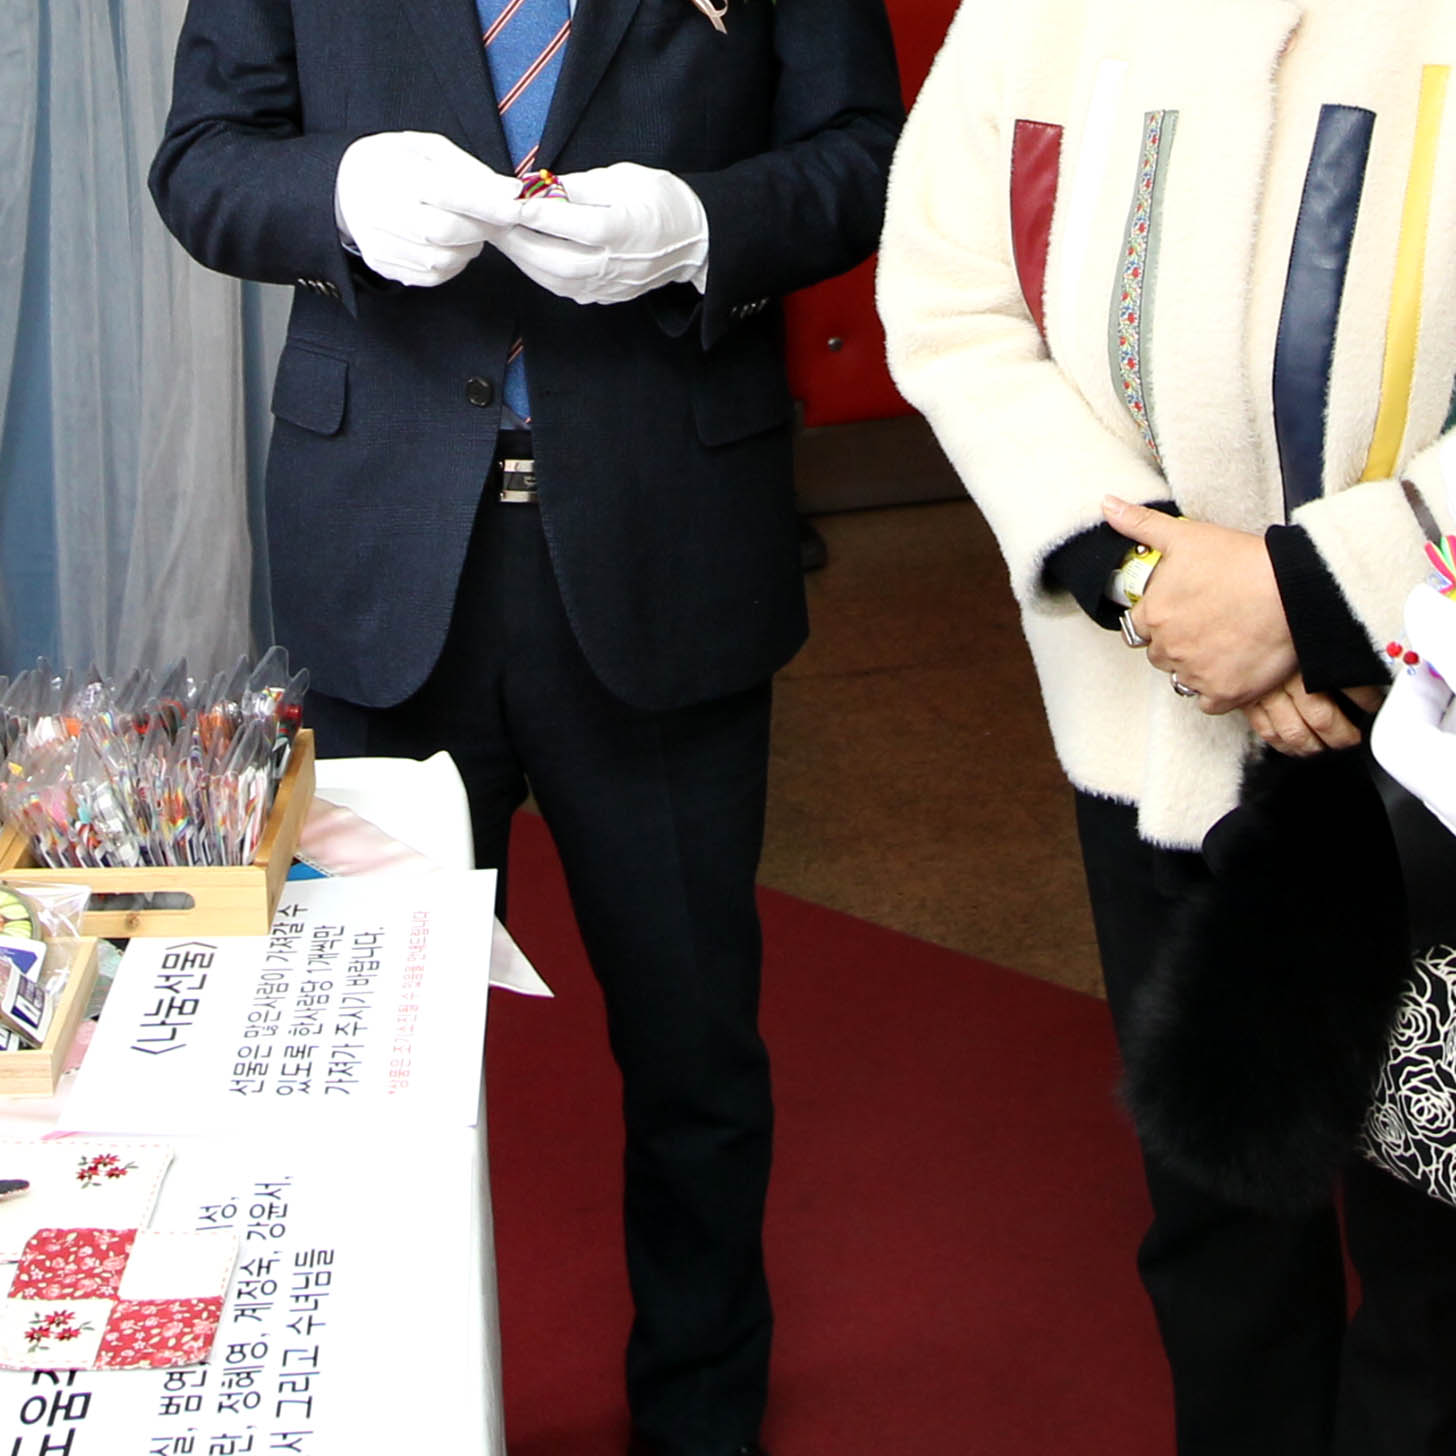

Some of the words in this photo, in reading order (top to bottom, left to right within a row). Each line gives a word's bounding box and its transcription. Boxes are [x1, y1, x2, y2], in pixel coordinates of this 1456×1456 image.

[277, 904, 308, 917] 수
[266, 922, 305, 962] 가져갈
[345, 927, 386, 987] 바랍니다.
[288, 980, 333, 1036] 한사람당
[334, 992, 375, 1037] 주시기
[229, 1045, 273, 1095] 선물은
[276, 1044, 319, 1095] 있도록
[324, 1044, 365, 1095] 가져가
[247, 1176, 292, 1240] 강윤서,
[233, 1250, 284, 1323] 계정숙,
[286, 1249, 335, 1336] 수녀님들
[218, 1333, 270, 1413] 정혜영,
[275, 1345, 321, 1419] 그리고
